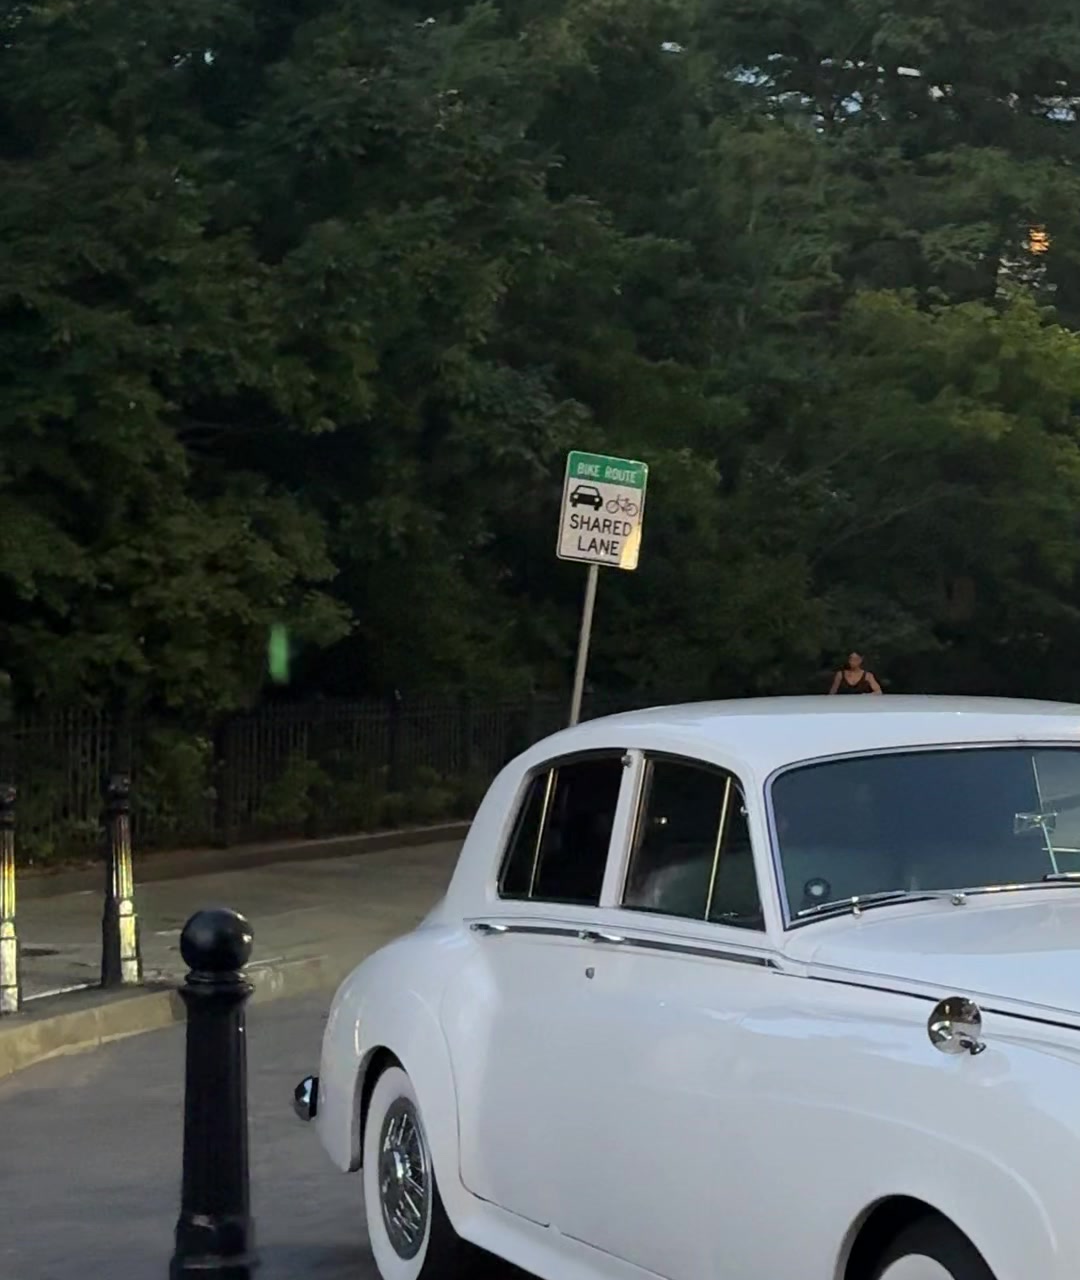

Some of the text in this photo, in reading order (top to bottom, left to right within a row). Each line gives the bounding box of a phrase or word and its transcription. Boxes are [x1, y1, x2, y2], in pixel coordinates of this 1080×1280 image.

[577, 462, 638, 483] BIKE ROUTE
[569, 513, 632, 537] SHARED
[577, 535, 620, 556] LANE
